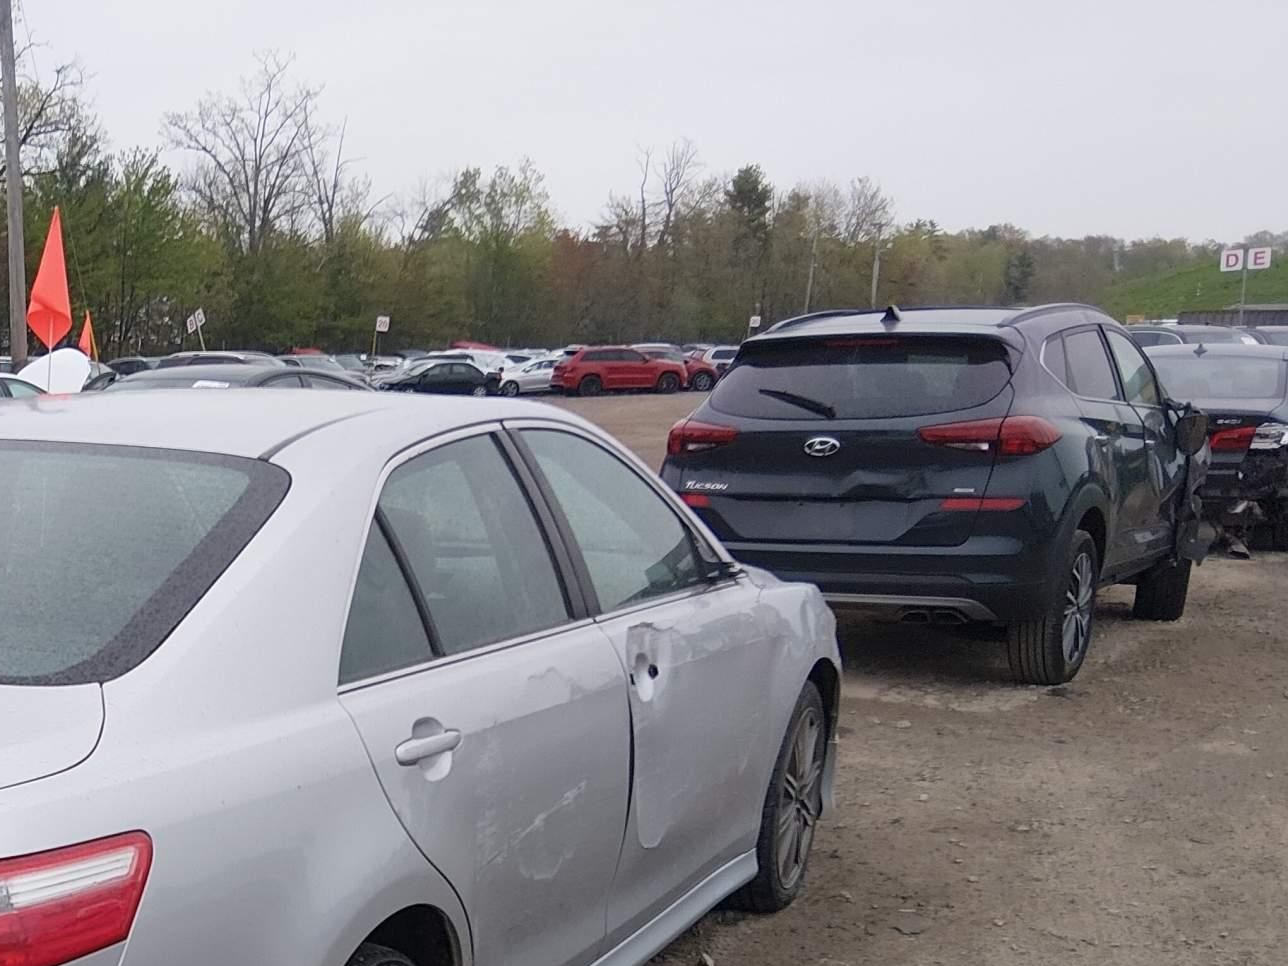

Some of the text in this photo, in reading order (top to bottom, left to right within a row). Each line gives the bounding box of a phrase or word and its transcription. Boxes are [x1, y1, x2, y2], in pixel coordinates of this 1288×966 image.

[1225, 250, 1266, 267] D E
[685, 480, 729, 490] TUCSON
